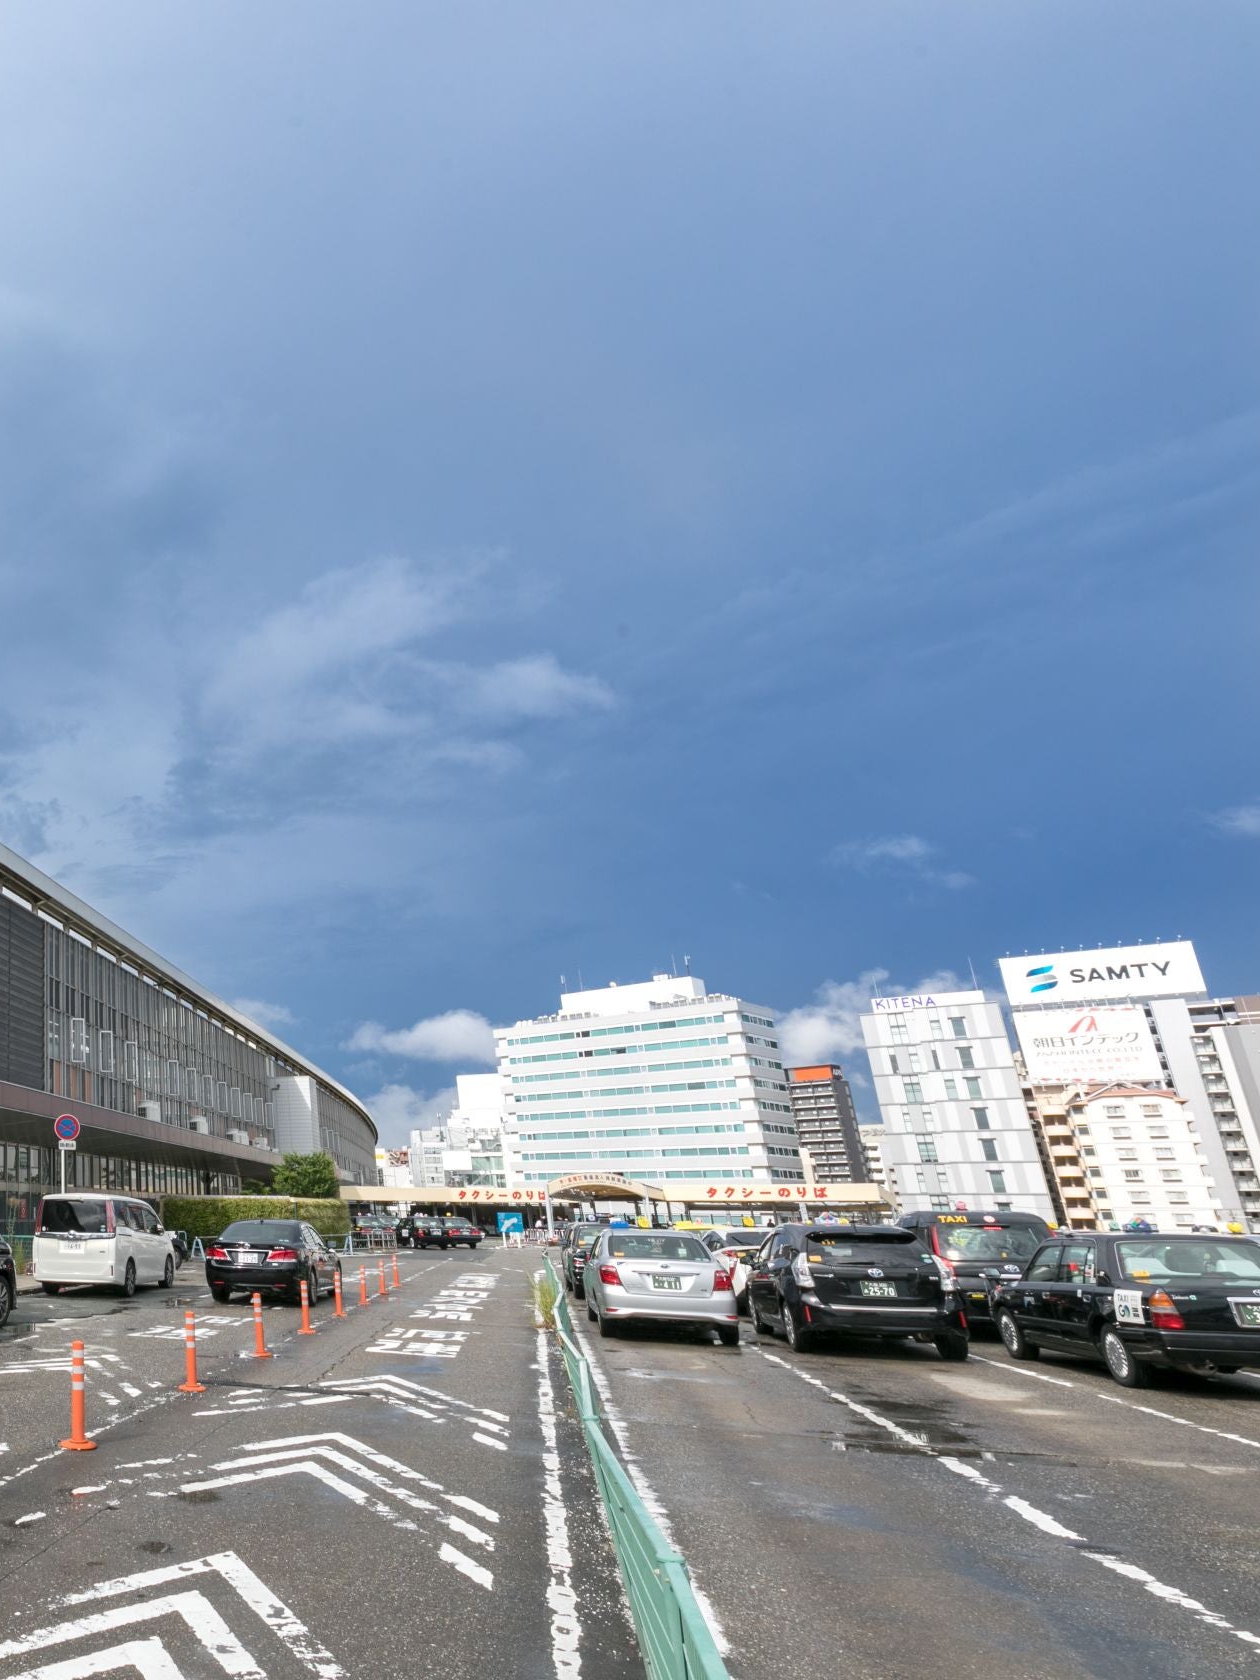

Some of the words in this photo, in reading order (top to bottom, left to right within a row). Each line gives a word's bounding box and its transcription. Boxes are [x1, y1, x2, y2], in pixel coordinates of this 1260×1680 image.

[1069, 961, 1171, 983] SAMTY
[875, 996, 936, 1010] KITENA
[1033, 1032, 1139, 1049] 朝日インテック
[706, 1186, 828, 1198] タクシーのりば
[937, 1215, 968, 1223] TAXI
[1117, 1293, 1129, 1302] TAXI
